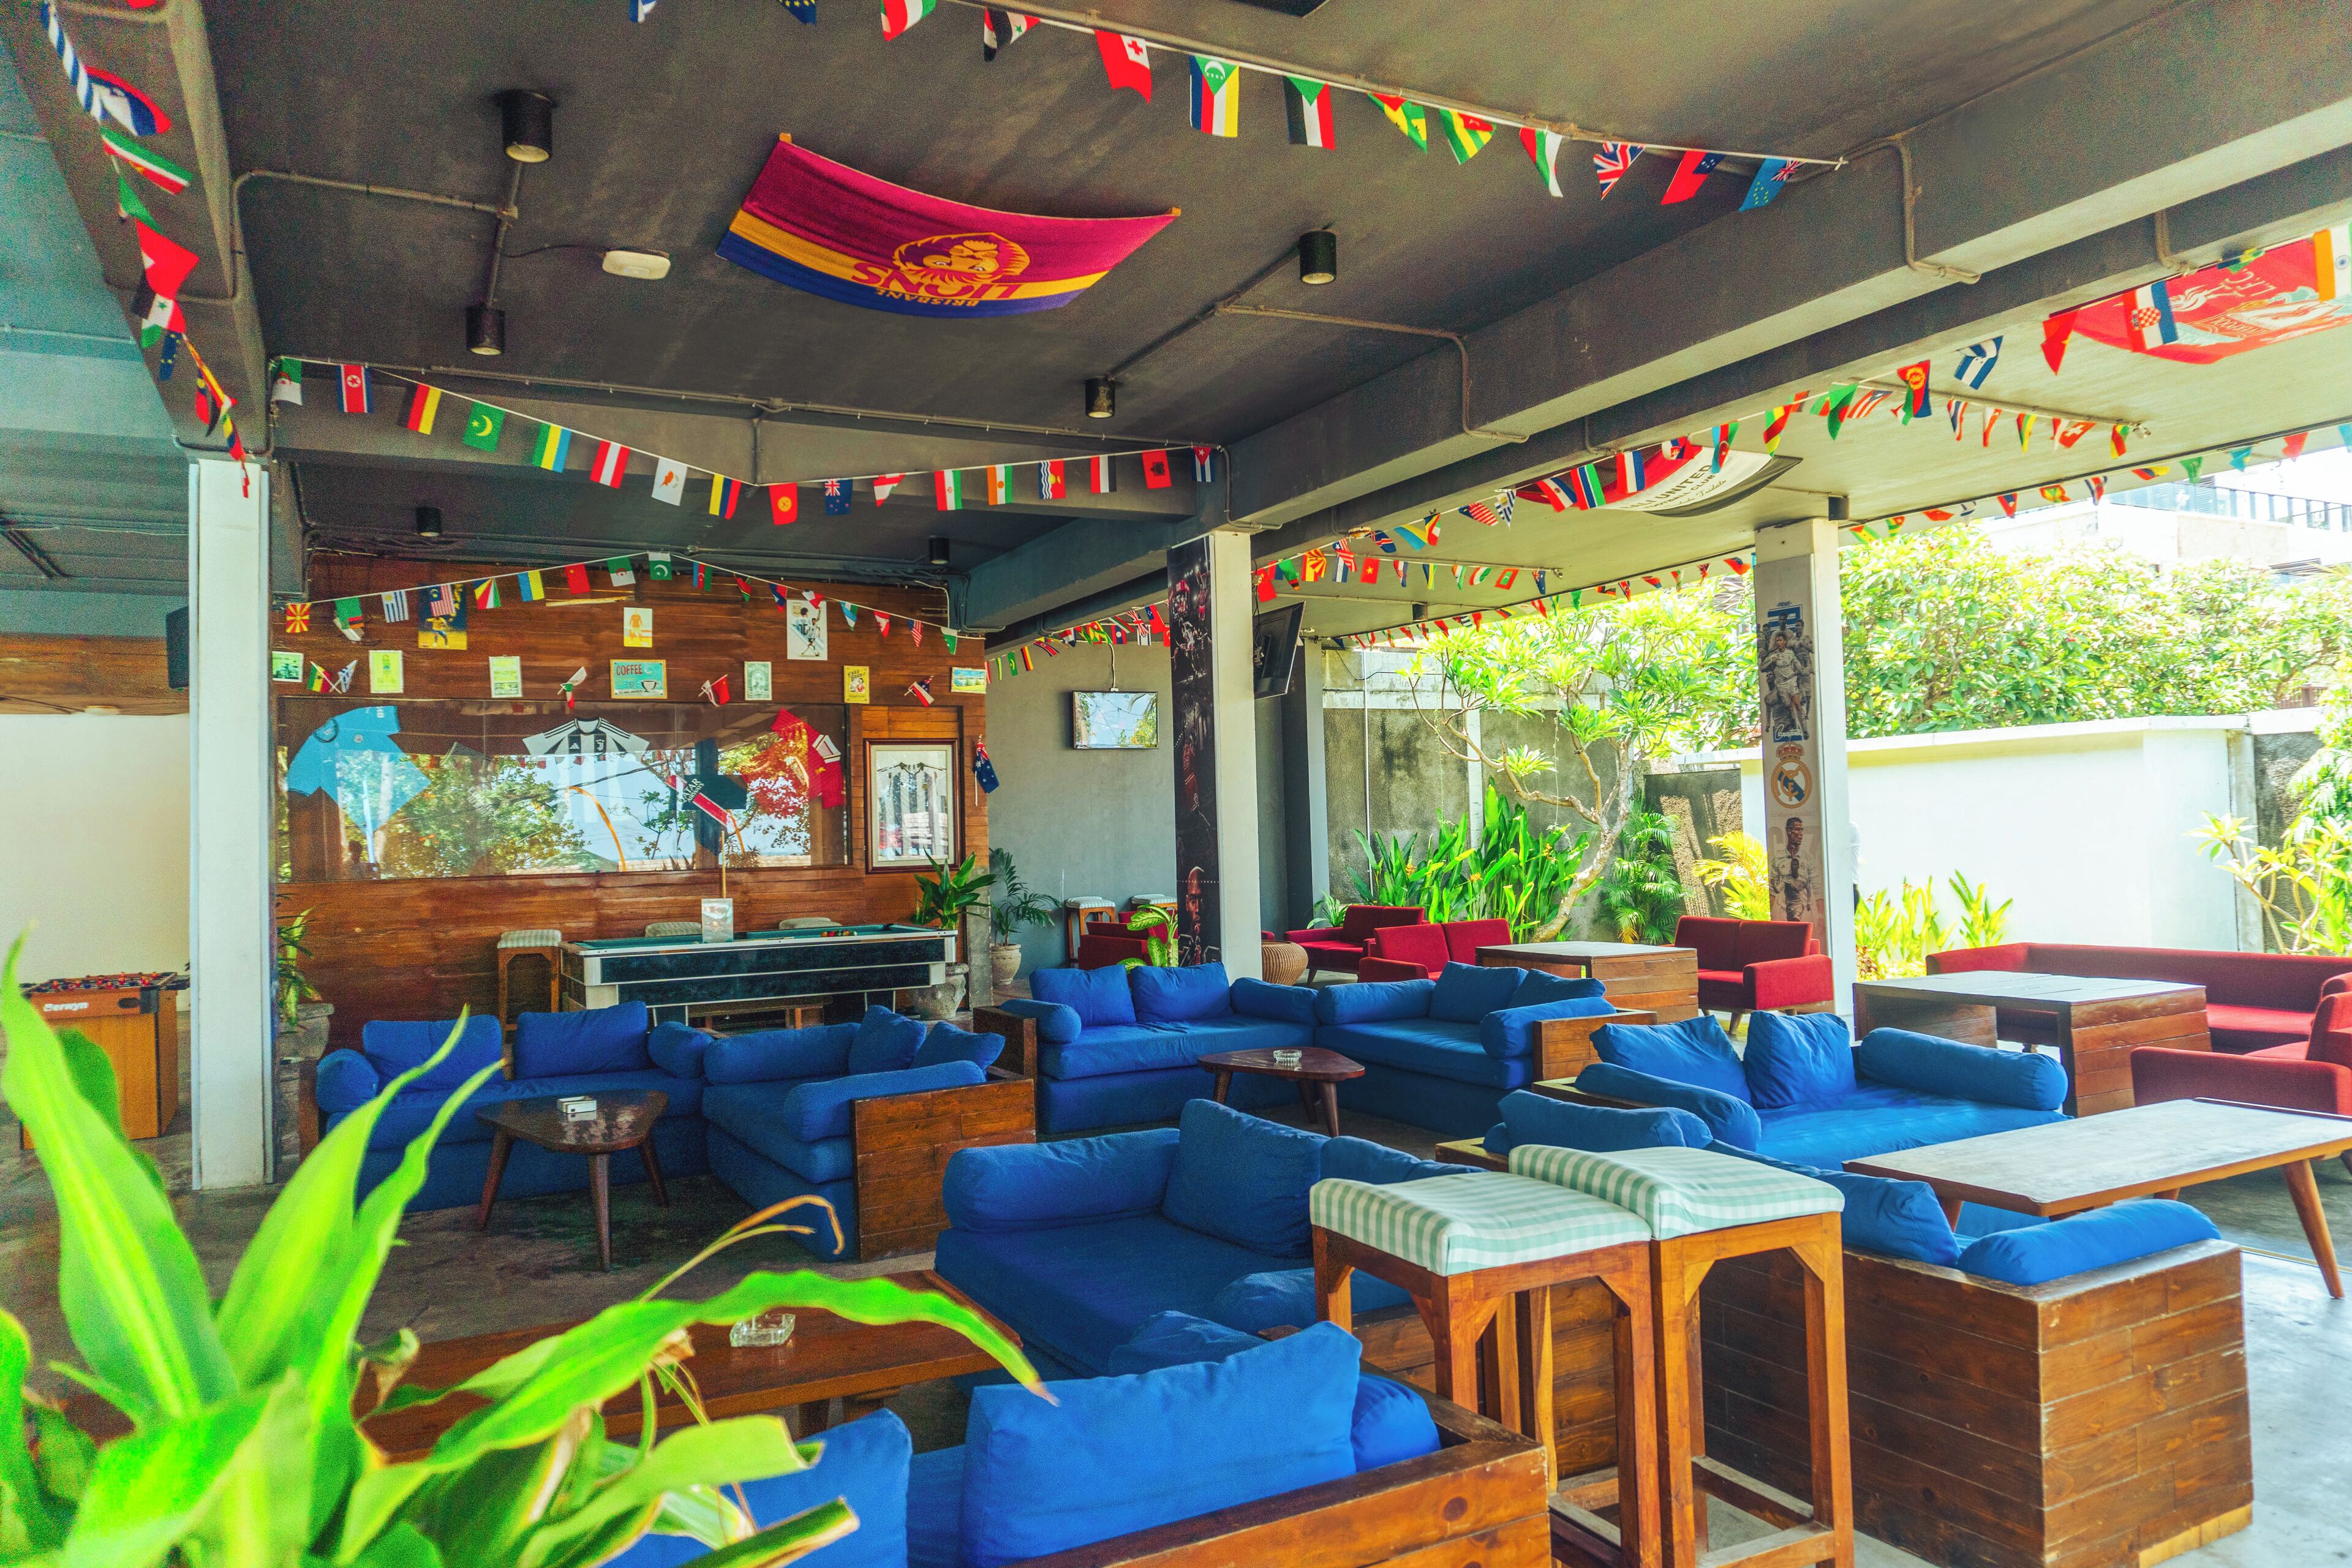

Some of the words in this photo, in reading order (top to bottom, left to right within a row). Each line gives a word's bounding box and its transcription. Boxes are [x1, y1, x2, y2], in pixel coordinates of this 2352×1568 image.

[851, 263, 1022, 298] LIONS
[875, 288, 979, 307] BRISBANE
[1655, 465, 1712, 499] UNITED
[1691, 474, 1716, 491] CLUB
[616, 665, 643, 676] COFFEE
